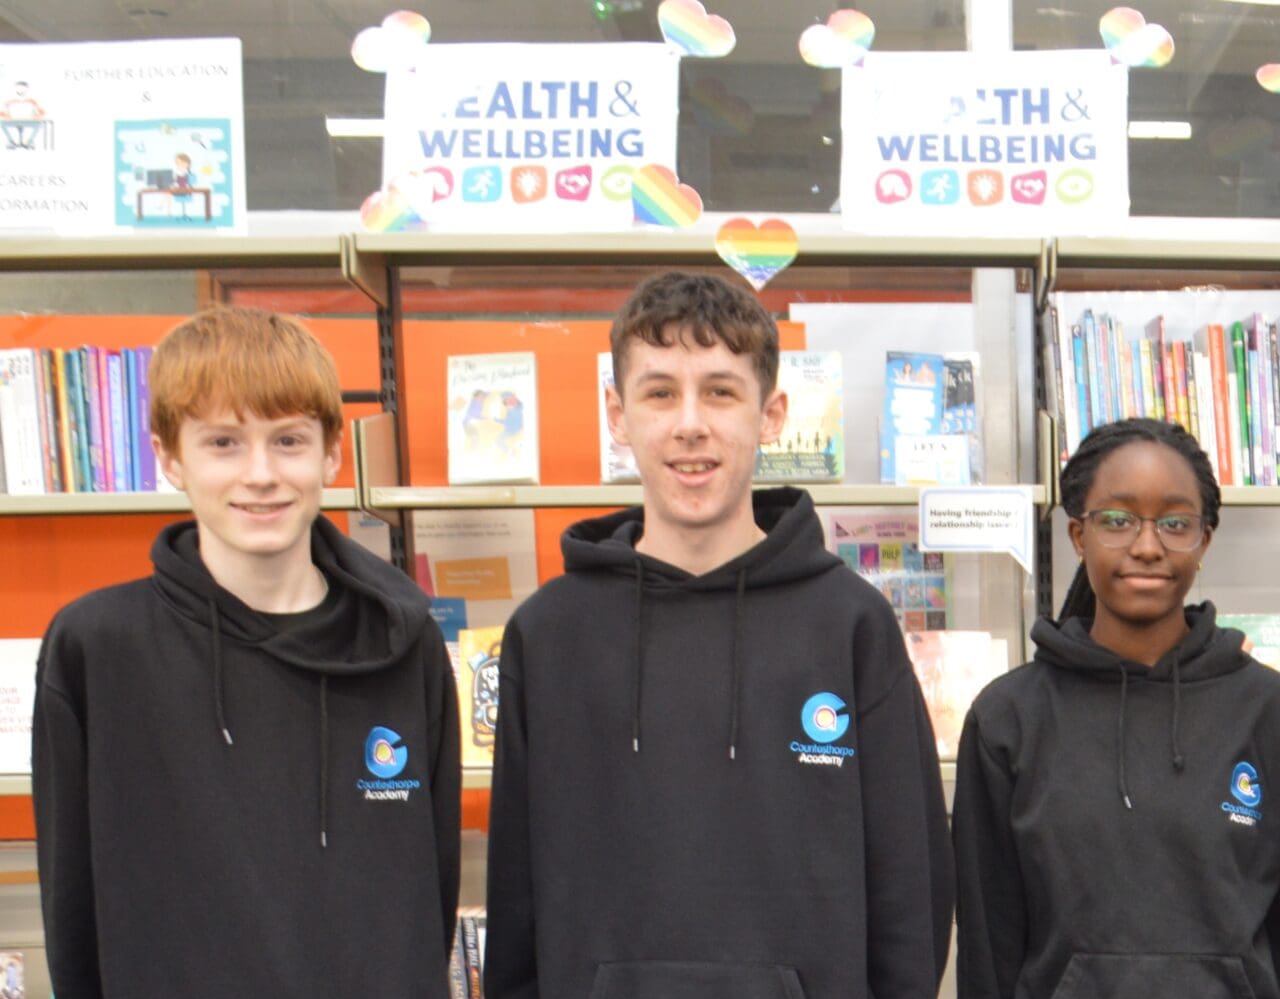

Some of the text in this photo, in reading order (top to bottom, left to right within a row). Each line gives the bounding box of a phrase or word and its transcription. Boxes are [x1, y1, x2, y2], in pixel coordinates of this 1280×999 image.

[63, 66, 134, 81] FURTHER
[607, 80, 641, 117] &
[1060, 88, 1091, 122] &
[418, 129, 645, 159] WELLBEING
[876, 133, 1096, 163] WELLBEING
[929, 508, 962, 518] Having
[964, 508, 1012, 518] friendship
[929, 520, 984, 530] relationship
[799, 753, 844, 767] Academy
[364, 789, 409, 801] Academy
